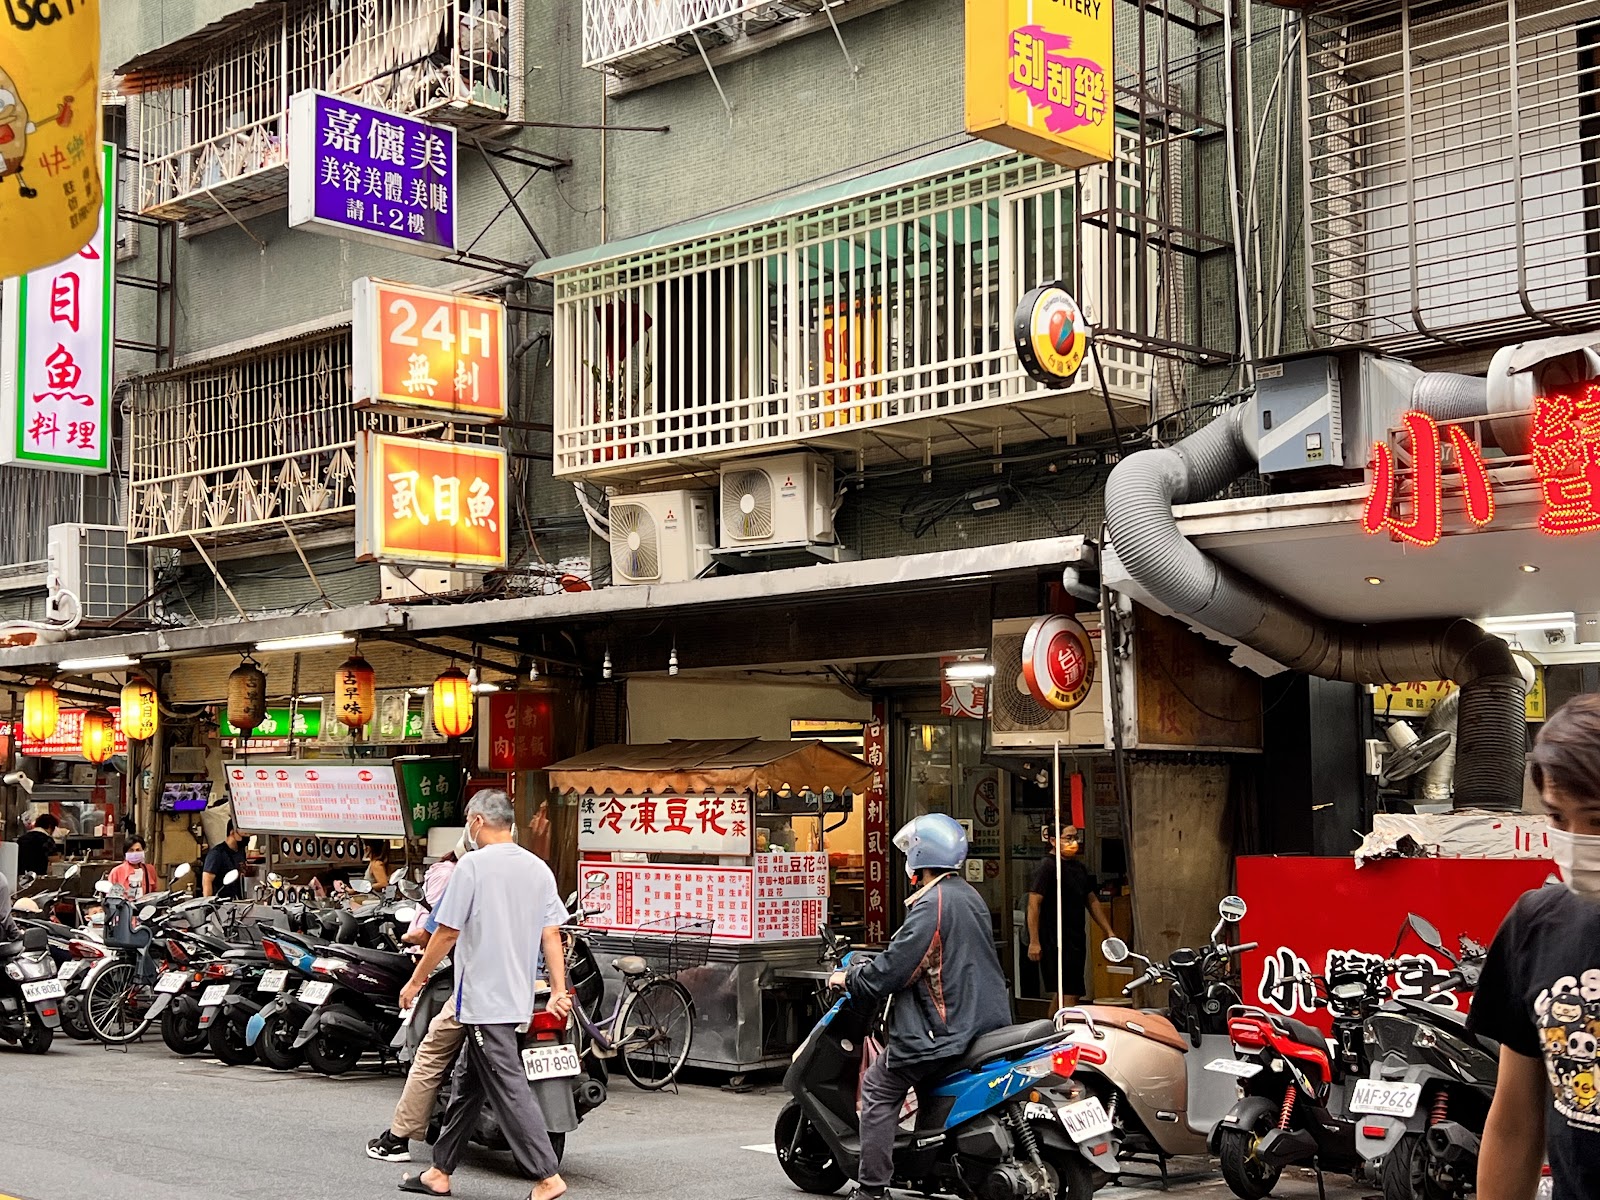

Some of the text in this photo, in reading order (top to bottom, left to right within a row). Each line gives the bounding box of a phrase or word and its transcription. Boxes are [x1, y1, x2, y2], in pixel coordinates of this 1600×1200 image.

[1013, 30, 1105, 126] 刮刮樂
[322, 107, 447, 177] 嘉儷美
[346, 198, 425, 236] 請上2樓
[389, 298, 490, 358] 24H
[402, 352, 480, 403] 無刺
[27, 411, 96, 449] 料理
[388, 470, 497, 533] 虱目魚
[343, 673, 362, 715] 古早味
[505, 705, 537, 729] 台南
[419, 775, 450, 796] 台南
[599, 797, 728, 836] 冷凍豆花
[731, 799, 747, 837] 紅茶
[790, 855, 815, 872] 豆花
[817, 855, 826, 864] 40
[817, 875, 826, 884] 45
[817, 886, 825, 895] 35
